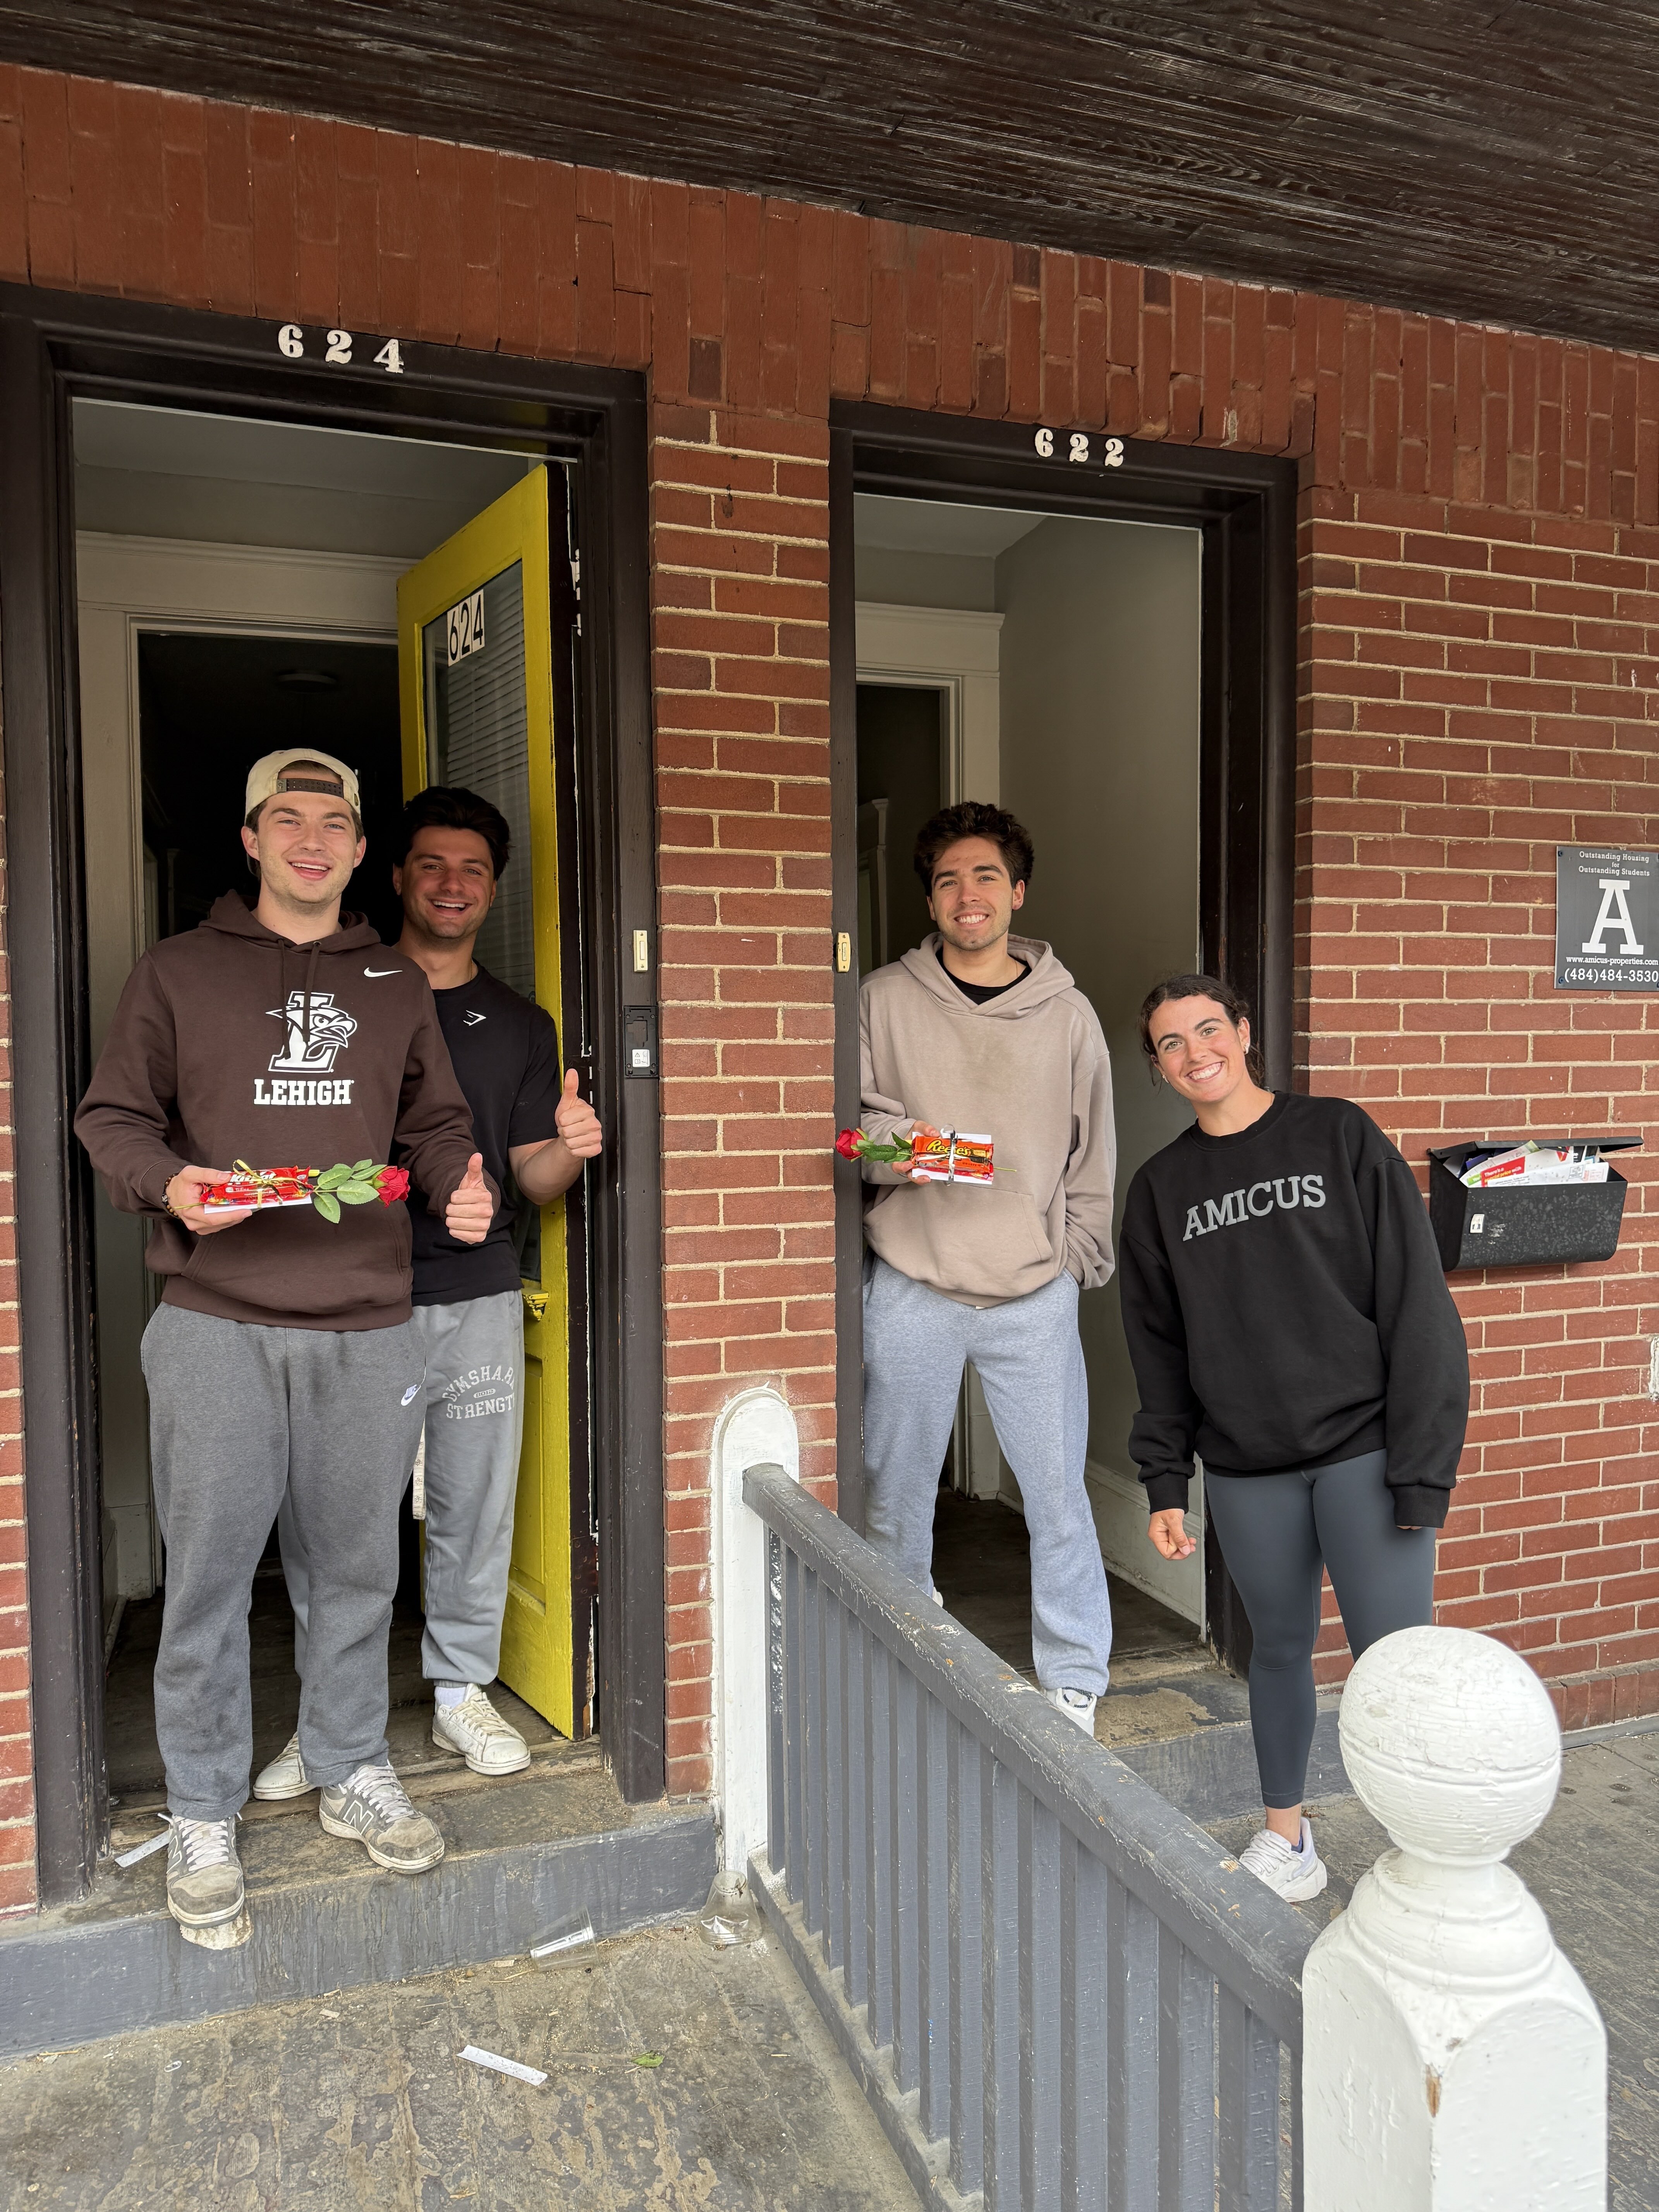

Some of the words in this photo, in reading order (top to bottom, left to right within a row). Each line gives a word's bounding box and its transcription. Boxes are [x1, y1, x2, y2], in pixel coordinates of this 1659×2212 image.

[278, 325, 404, 374] 624
[1034, 428, 1124, 467] 622
[450, 594, 483, 661] 624
[1579, 851, 1621, 862] Outstanding
[1623, 854, 1650, 863] Housing
[1578, 866, 1620, 876] Outstanding
[1621, 868, 1650, 876] Students
[1582, 879, 1644, 955] A
[1566, 956, 1659, 966] www.amicus-properties.com
[1564, 968, 1659, 984] (484)484-3530
[254, 1079, 352, 1106] LEHIGH
[926, 1139, 970, 1156] Reee's
[1484, 1168, 1500, 1177] There's
[1499, 1169, 1512, 1178] price
[1182, 1174, 1326, 1242] AMICUS
[446, 1392, 515, 1420] STRENGT
[342, 1799, 374, 1836] N
